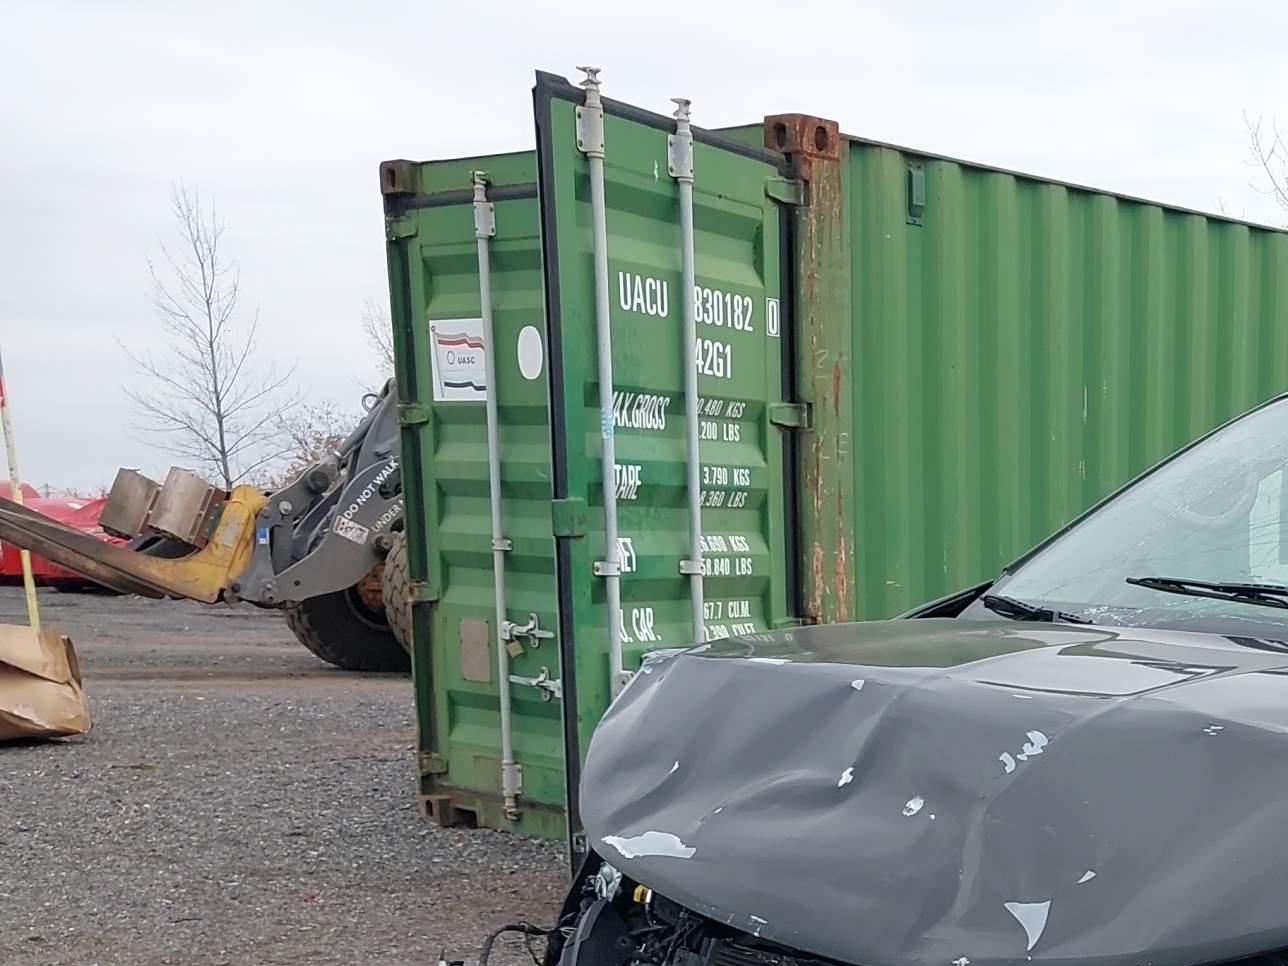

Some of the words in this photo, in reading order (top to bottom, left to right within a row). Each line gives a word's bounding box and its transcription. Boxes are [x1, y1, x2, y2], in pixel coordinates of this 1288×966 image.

[618, 271, 669, 318] UACU
[694, 285, 754, 332] 830182
[457, 356, 476, 364] UASC
[695, 337, 732, 379] 42G1
[696, 397, 724, 416] 0.480
[725, 401, 746, 418] KGS
[698, 421, 718, 440] .200
[723, 423, 740, 441] LBS
[343, 503, 359, 520] DO
[356, 482, 377, 506] NOT
[373, 458, 399, 485] WALK
[614, 464, 642, 499] TARE
[703, 466, 728, 485] 3.790
[733, 468, 750, 486] KGS
[727, 491, 748, 508] LBS
[370, 503, 402, 533] UNDER
[700, 535, 728, 552] 6.690
[728, 535, 750, 552] KGS
[735, 558, 753, 575] LBS
[632, 607, 662, 641] CAP.
[703, 601, 722, 620] 67.7
